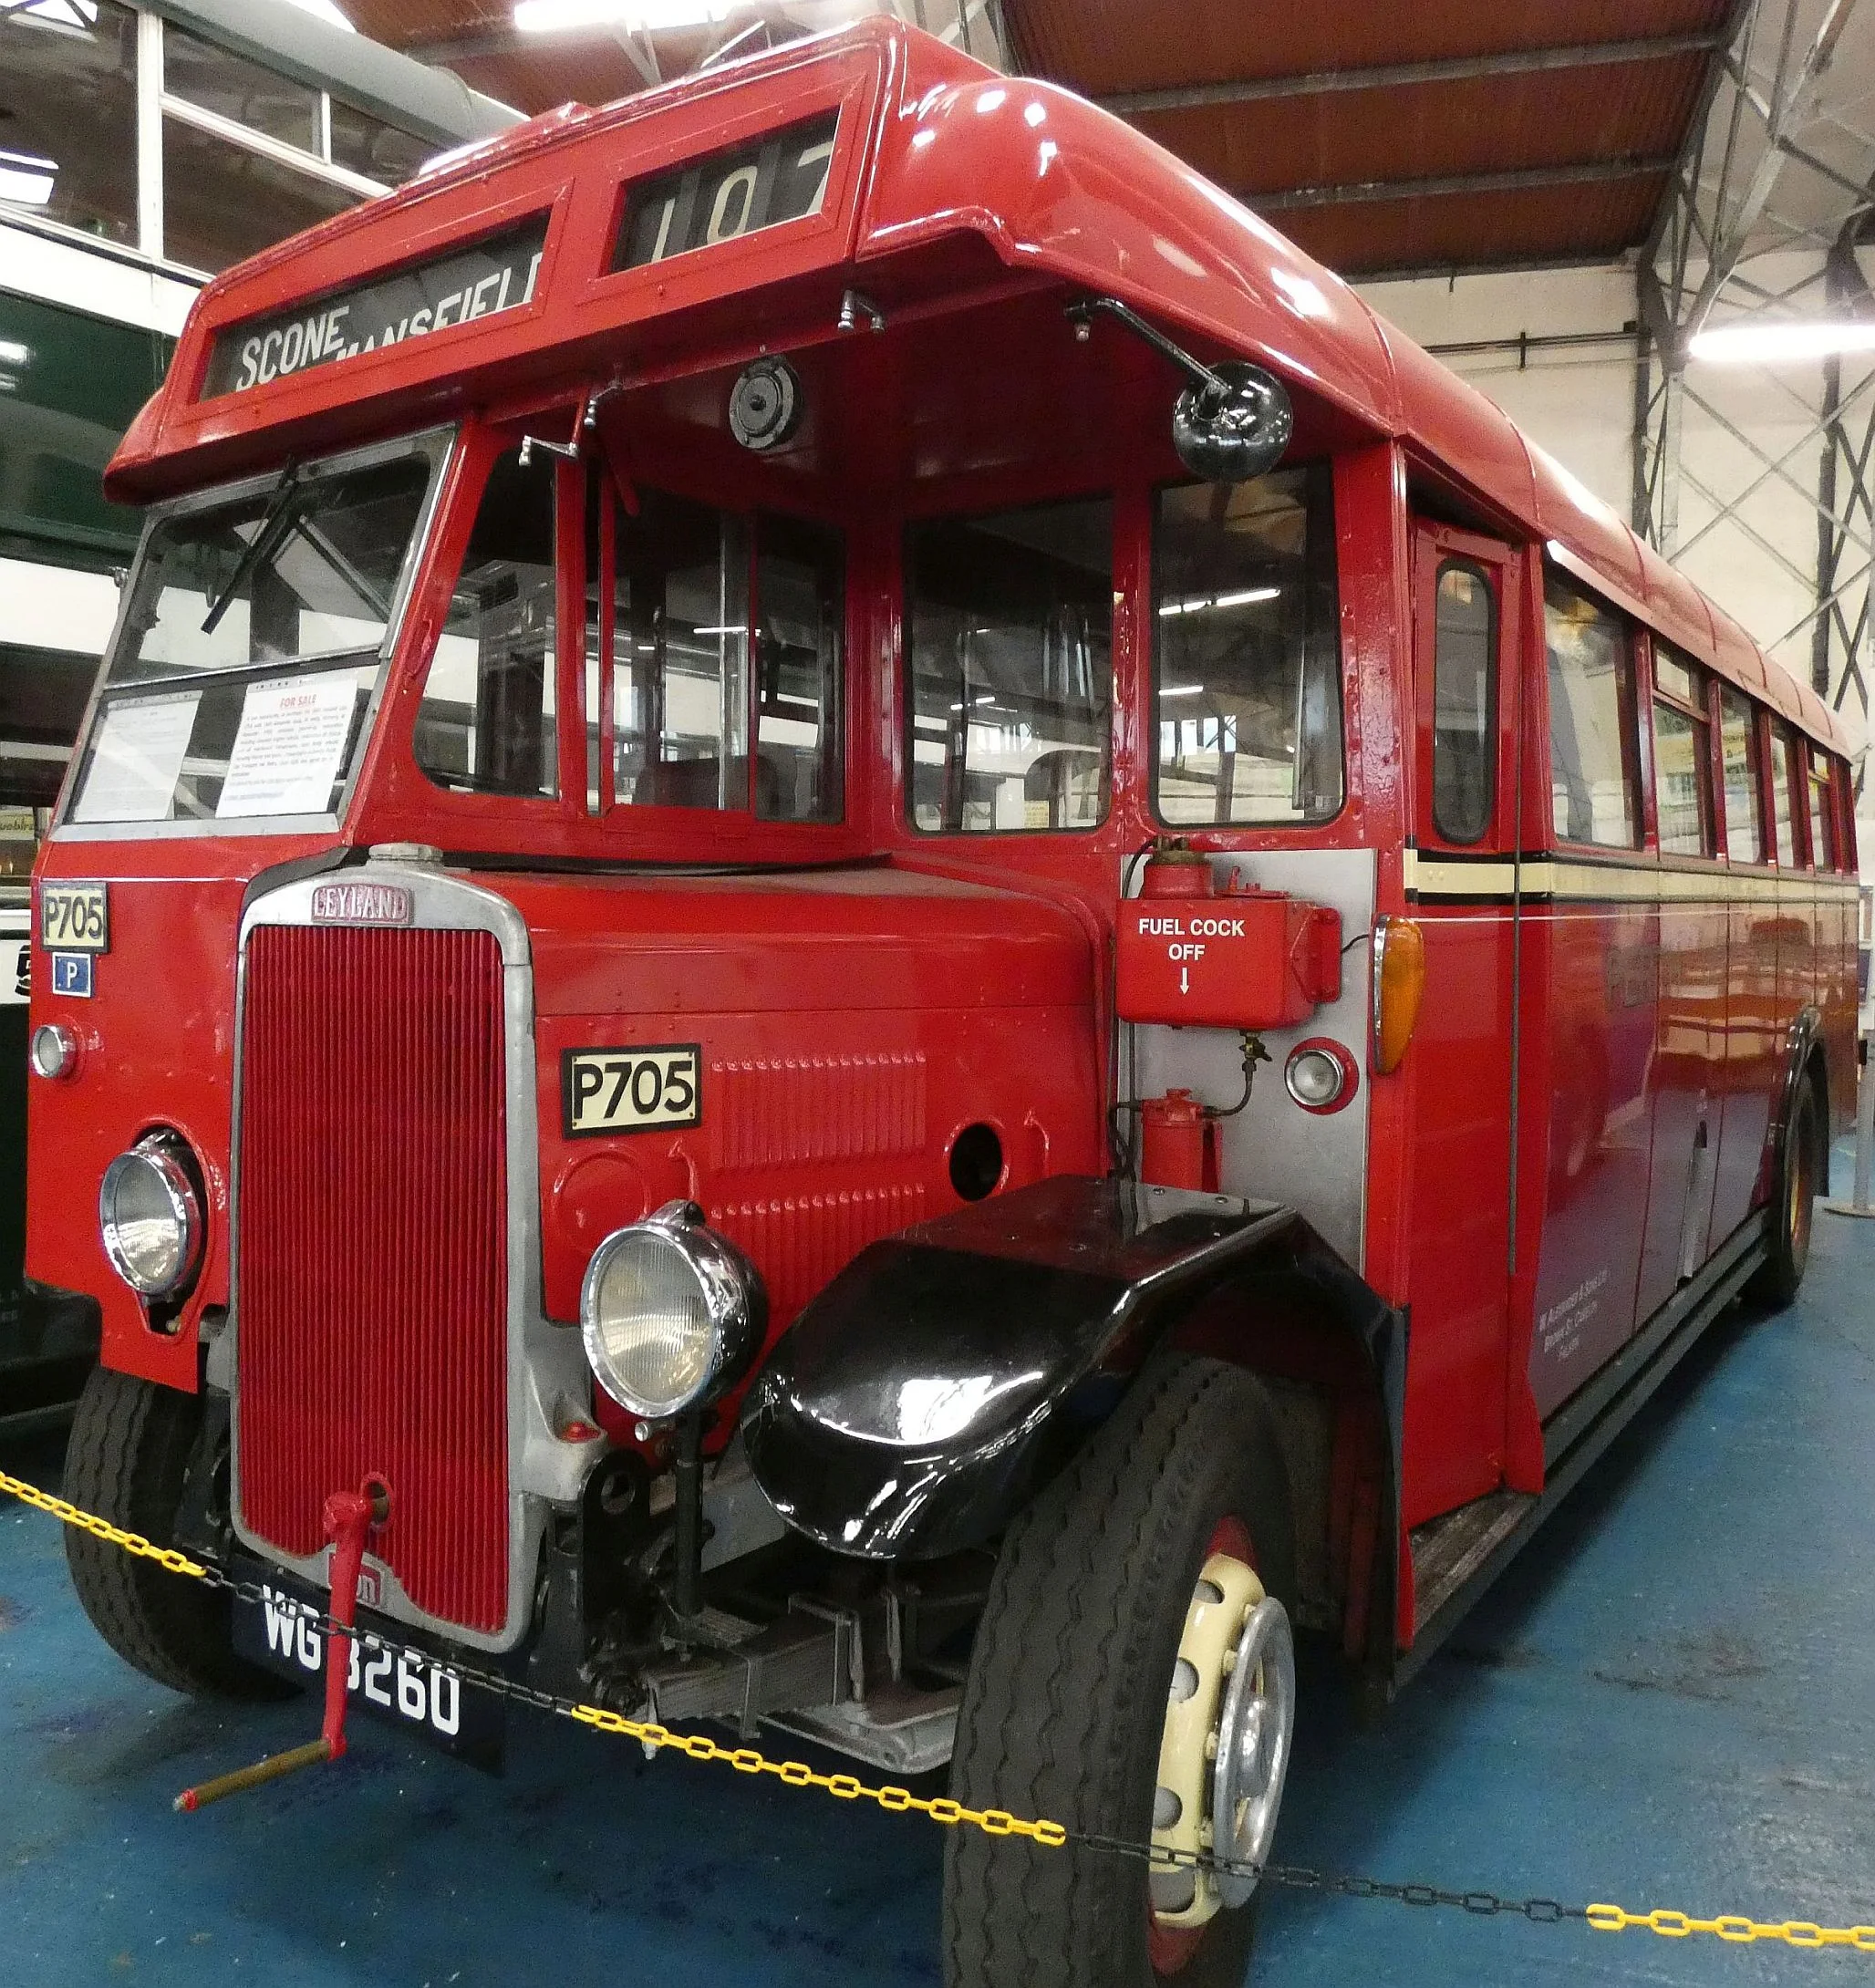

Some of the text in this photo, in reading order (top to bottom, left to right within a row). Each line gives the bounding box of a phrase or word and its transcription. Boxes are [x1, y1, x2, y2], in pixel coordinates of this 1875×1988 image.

[236, 305, 350, 392] SCONE
[280, 694, 317, 709] FOR SALE
[45, 896, 103, 940] P705
[314, 885, 408, 920] LEYLAND
[1139, 918, 1246, 937] FUEL COCK
[1168, 943, 1206, 961] OFF
[67, 962, 78, 989] P
[574, 1061, 694, 1120] P705
[263, 1584, 321, 1671] WG
